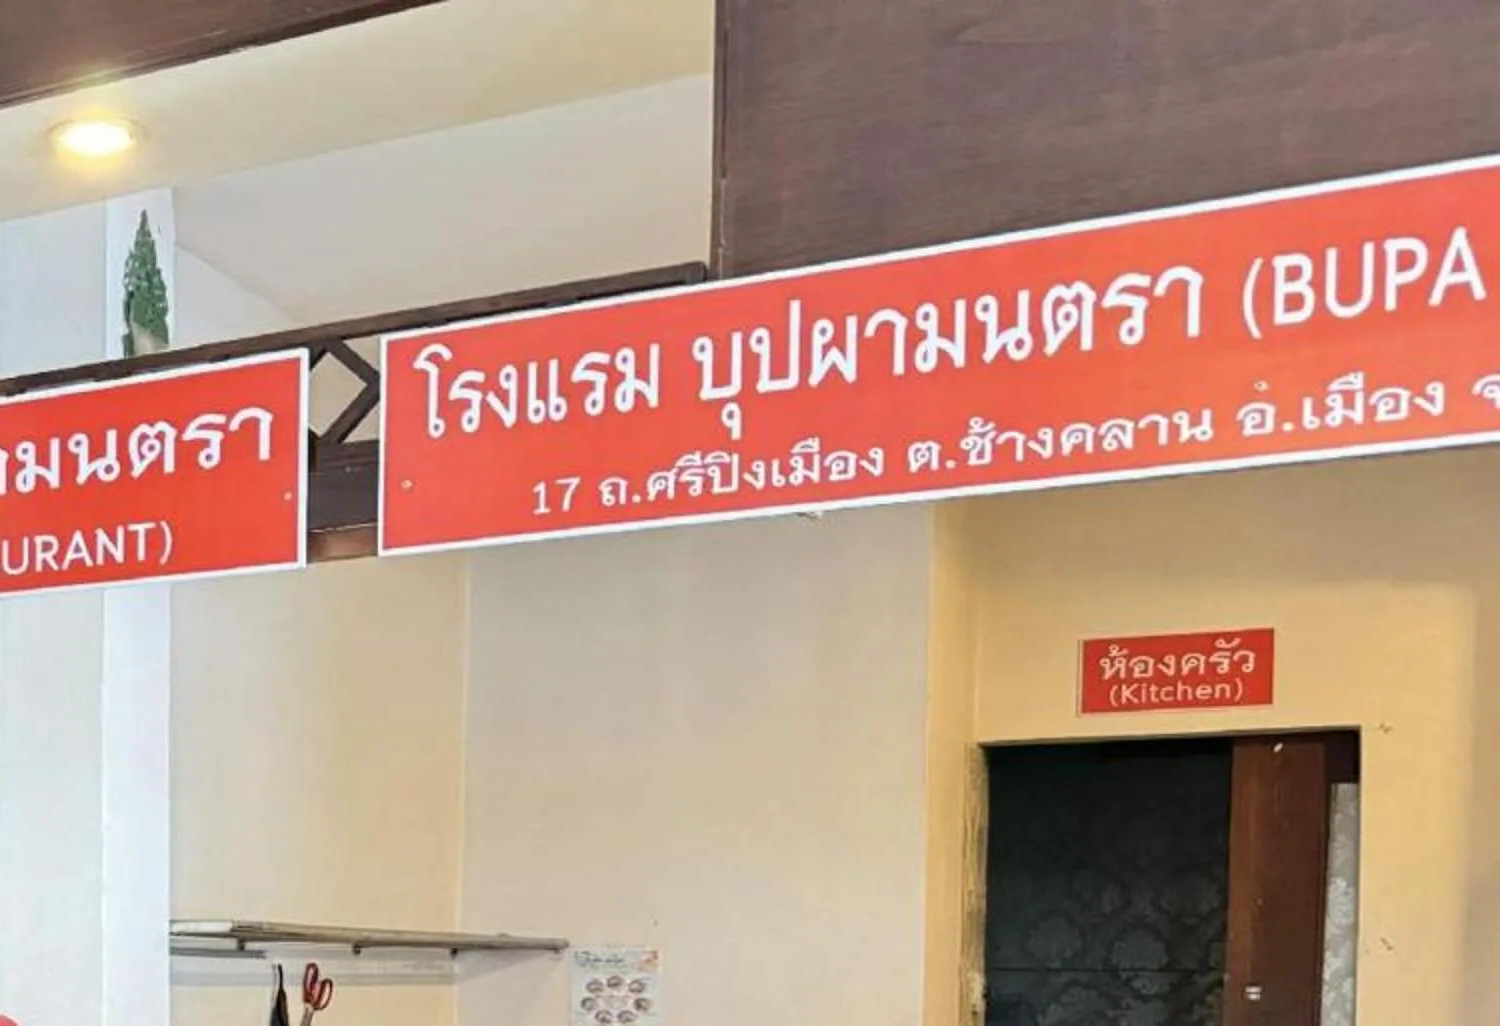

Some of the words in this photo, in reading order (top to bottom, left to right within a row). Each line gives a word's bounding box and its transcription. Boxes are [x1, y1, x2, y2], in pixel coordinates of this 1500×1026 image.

[412, 342, 661, 440] โรงแรม
[691, 264, 1204, 441] บุปผามนตรา
[1242, 225, 1487, 339] (BUPA
[532, 475, 581, 515] 17
[598, 436, 885, 507] ถ.ศรีปิงเมือง
[906, 407, 1214, 474] ต.ช้างคลาน
[1235, 370, 1446, 437] อ.เมือง
[1098, 637, 1257, 681] ห้องครัว
[1108, 678, 1244, 707] (Kitchen)
